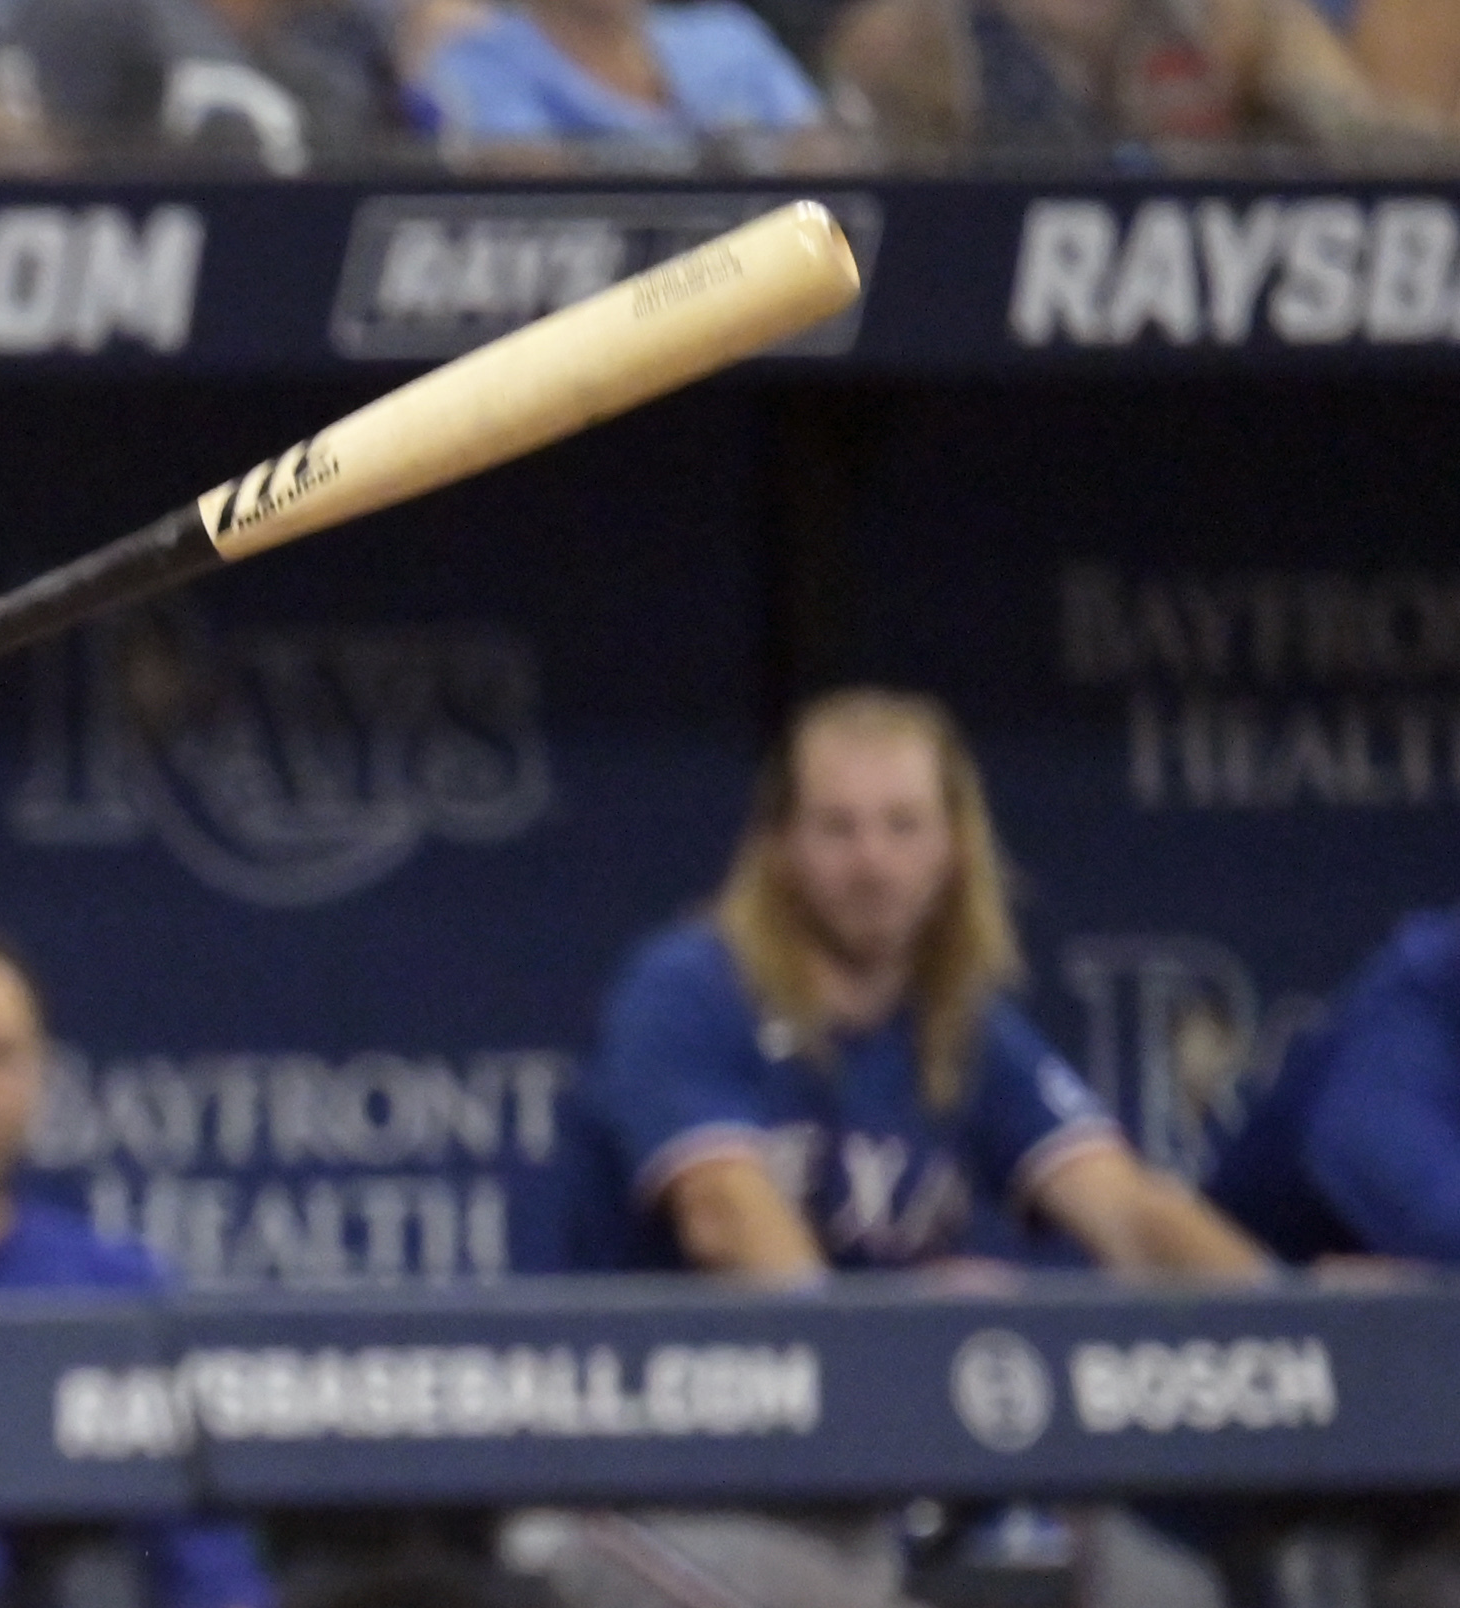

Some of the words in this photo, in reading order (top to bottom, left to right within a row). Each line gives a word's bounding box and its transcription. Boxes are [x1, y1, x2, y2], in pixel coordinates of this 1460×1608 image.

[378, 216, 626, 314] RAYS
[1008, 198, 1460, 346] RAYSB
[1067, 1336, 1339, 1435] BOSCH
